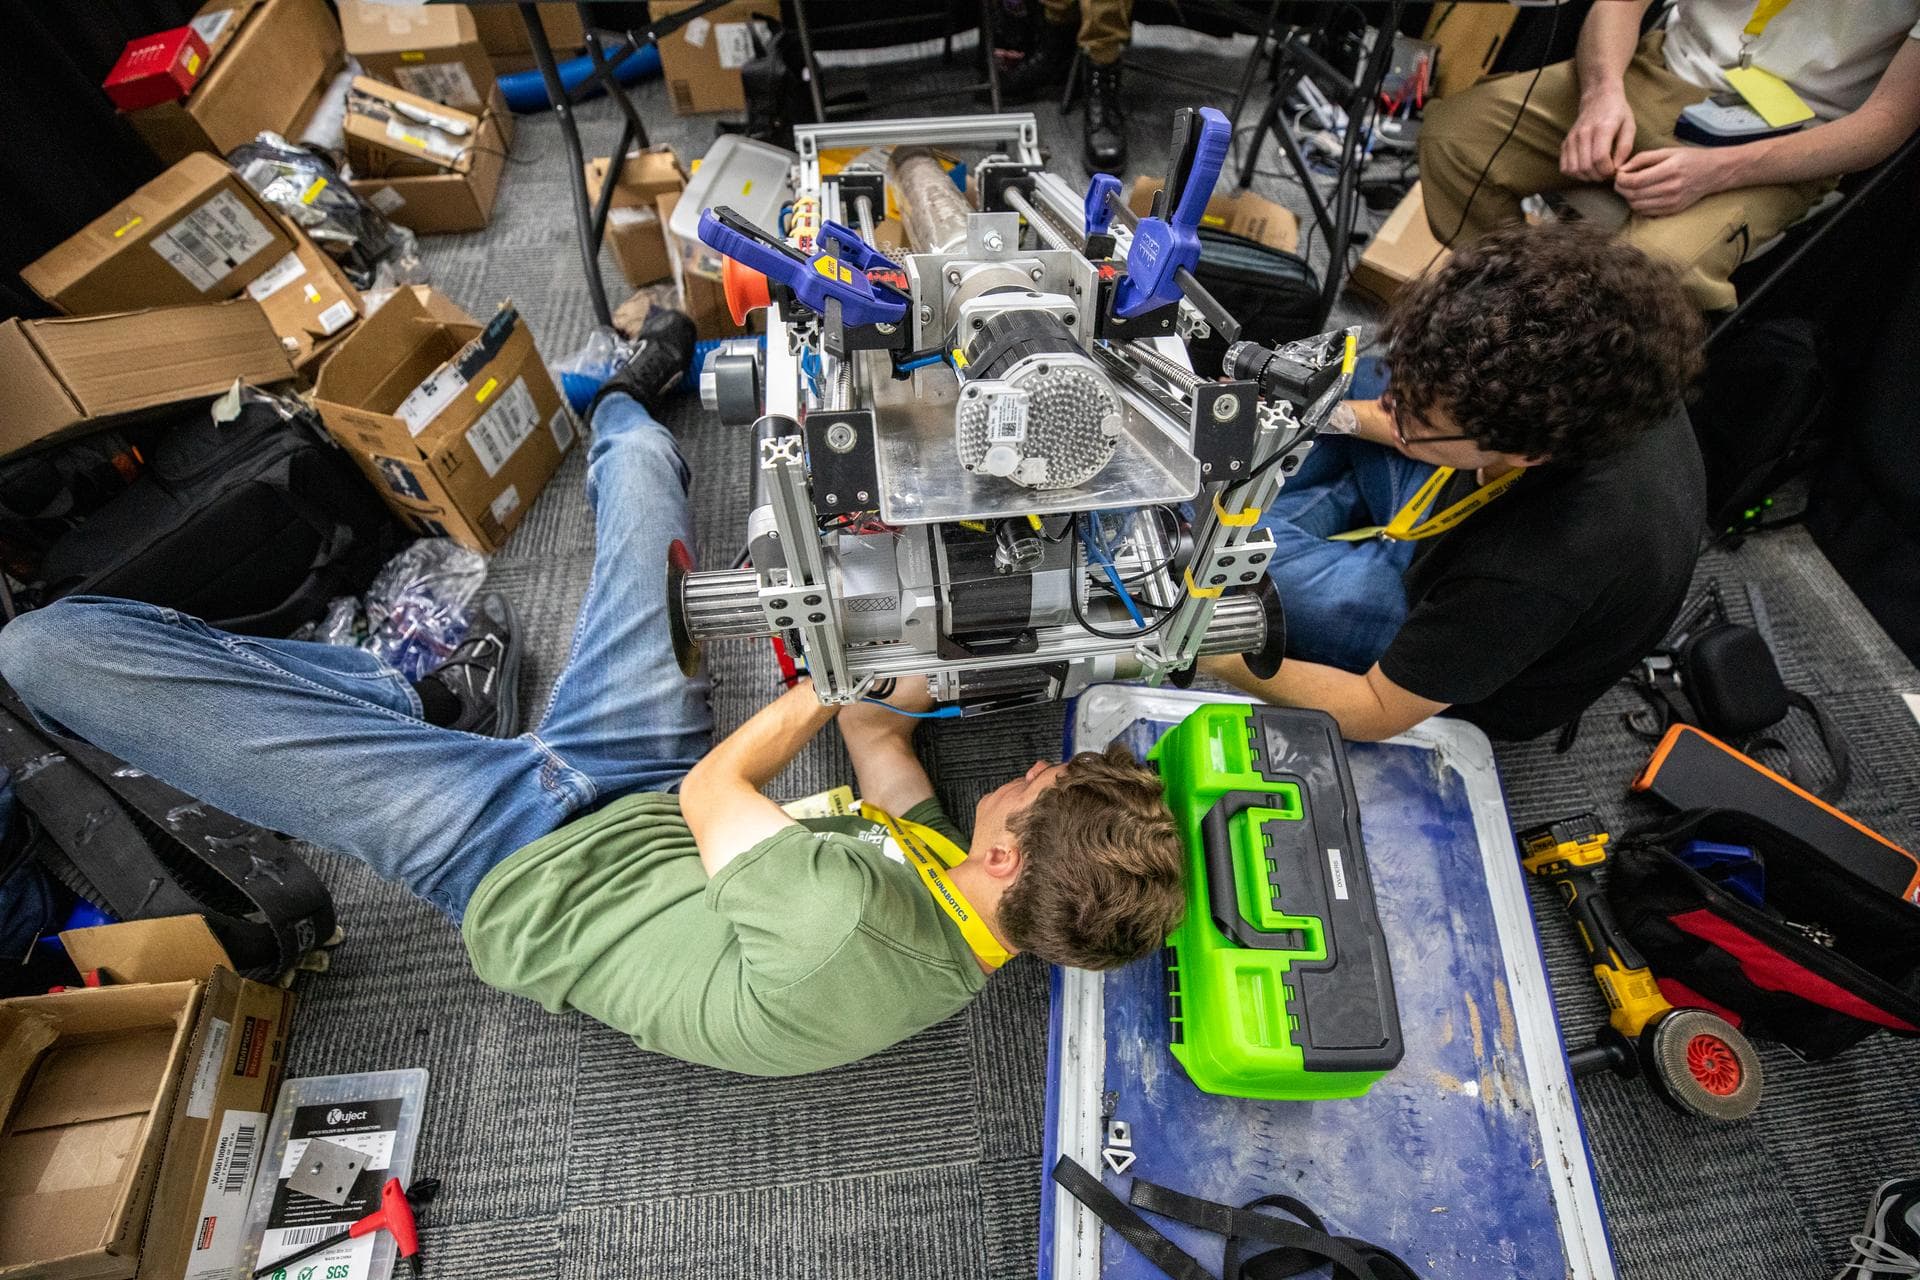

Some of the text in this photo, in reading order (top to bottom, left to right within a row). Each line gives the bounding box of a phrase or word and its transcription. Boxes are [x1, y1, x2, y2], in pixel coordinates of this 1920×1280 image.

[1333, 860, 1344, 888] DIVIDERS
[934, 877, 968, 922] LUNABOTICS
[327, 1108, 368, 1125] Kuject
[326, 1264, 350, 1280] SGS
